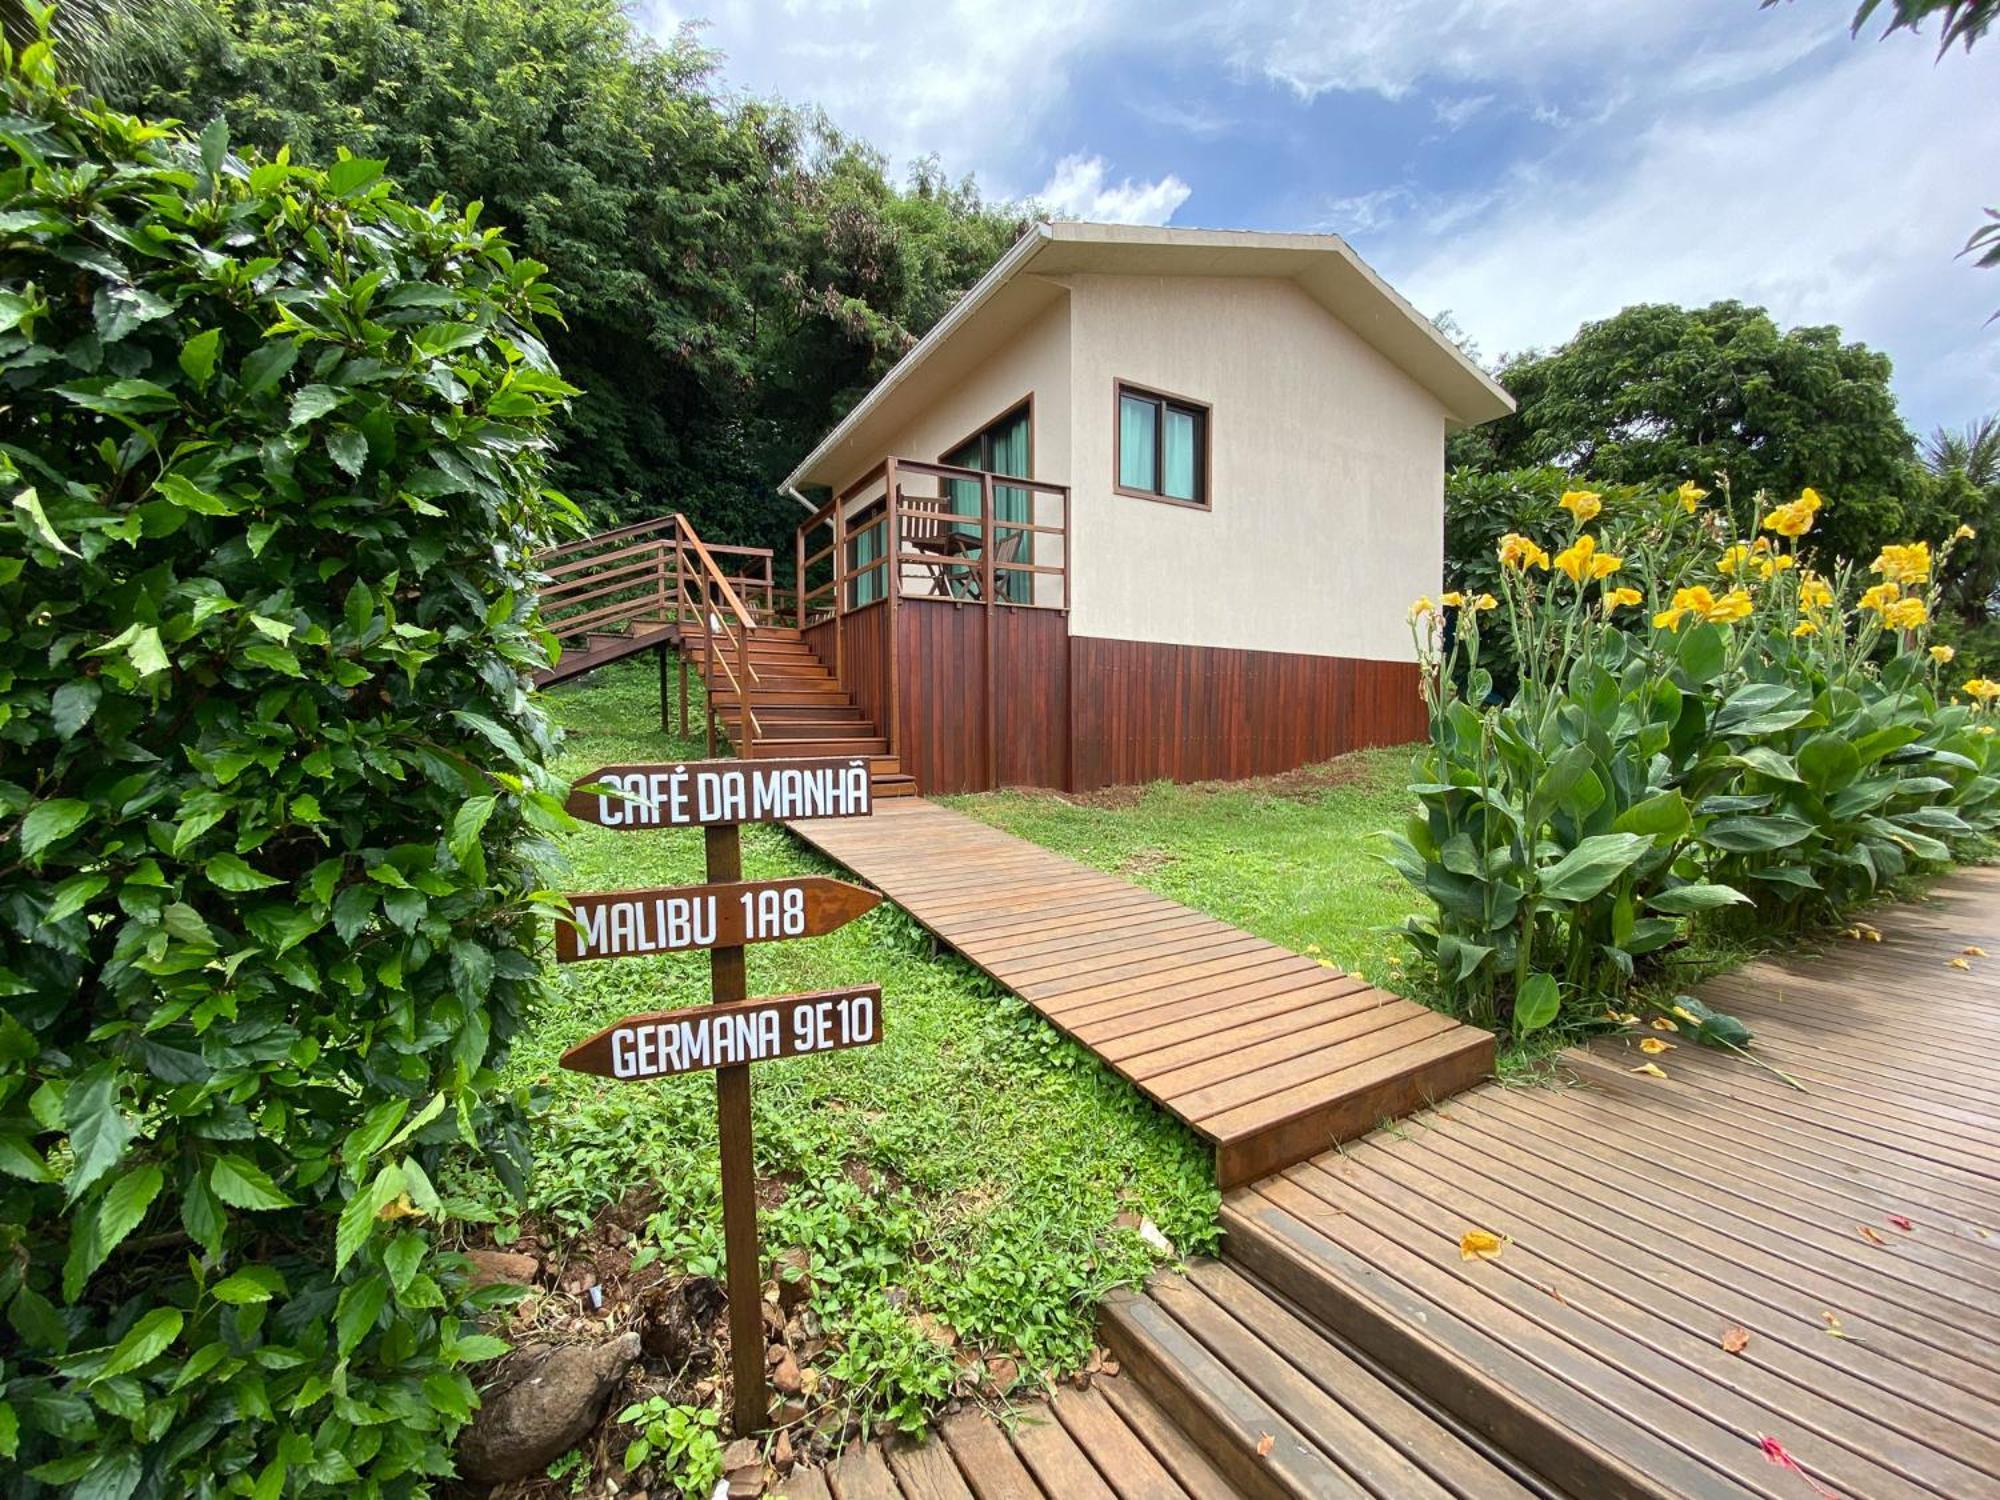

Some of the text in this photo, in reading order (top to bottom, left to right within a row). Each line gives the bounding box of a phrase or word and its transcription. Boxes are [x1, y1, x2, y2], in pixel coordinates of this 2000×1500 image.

[598, 760, 868, 825] CAFÉ DA MANHÃ
[575, 895, 717, 957] MALIBU
[611, 1009, 781, 1078] GERMANA
